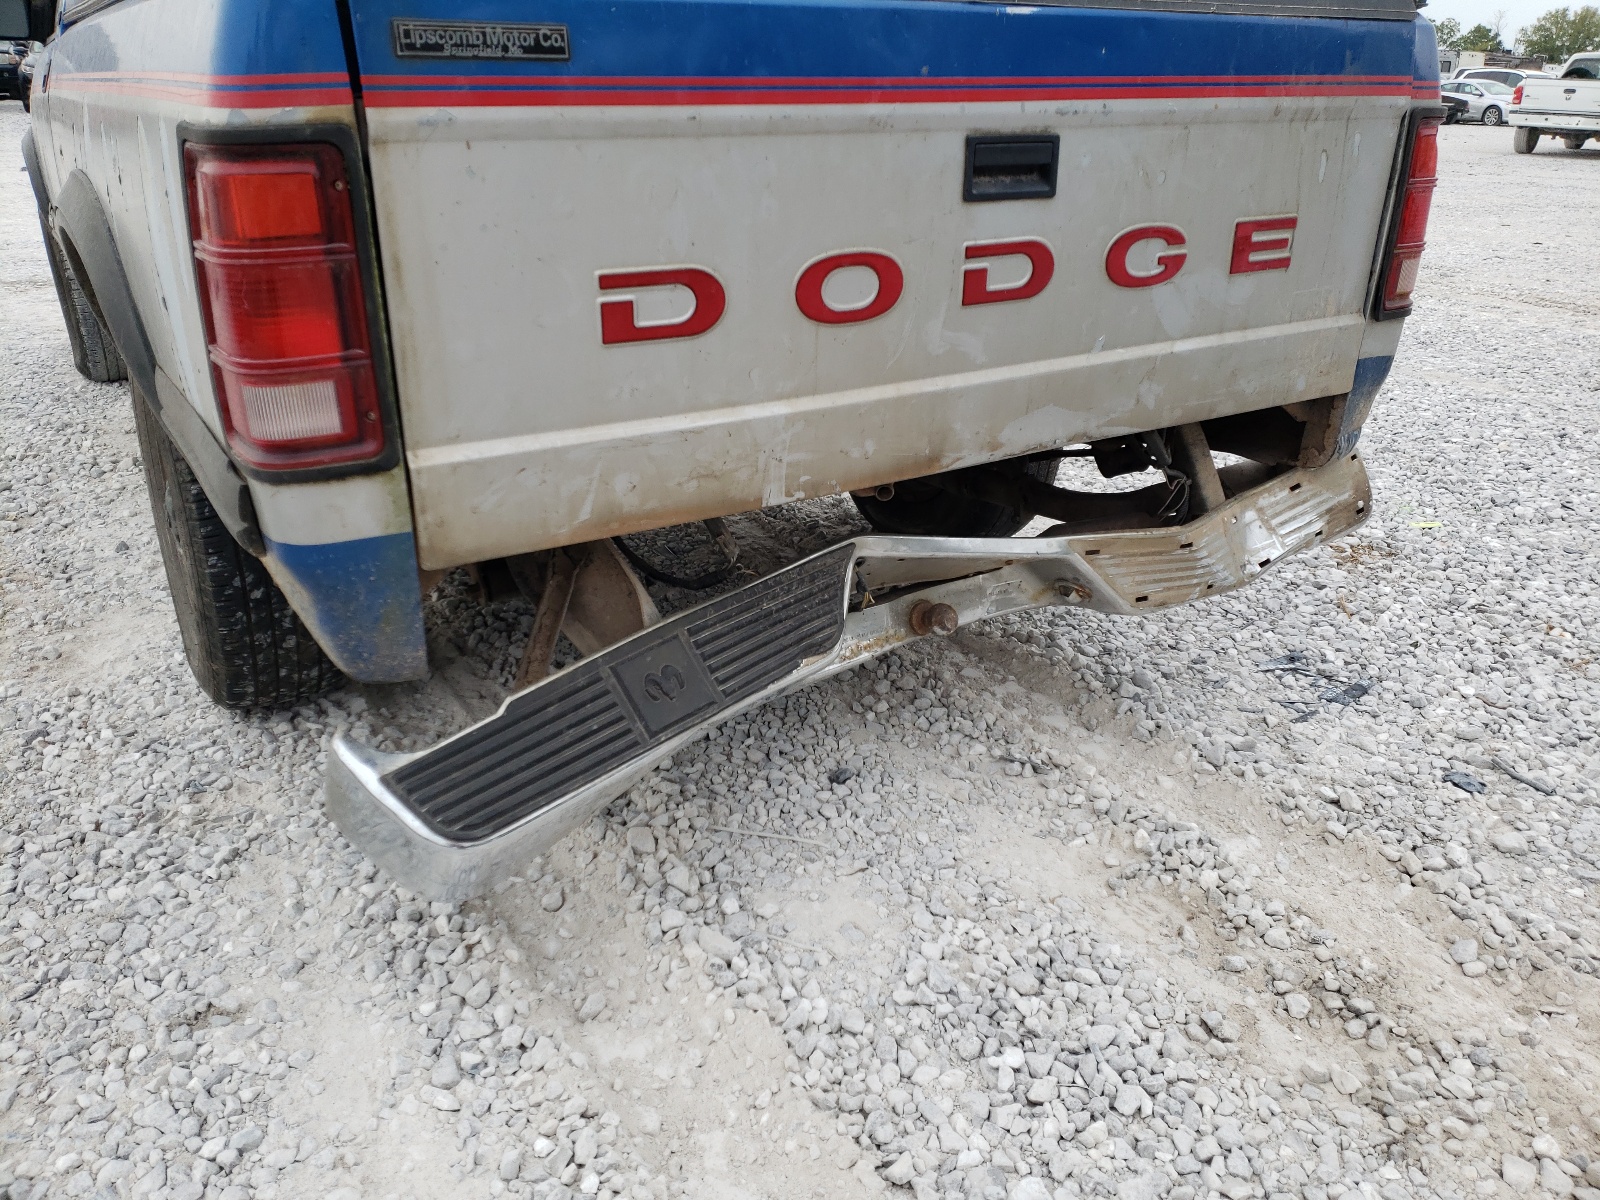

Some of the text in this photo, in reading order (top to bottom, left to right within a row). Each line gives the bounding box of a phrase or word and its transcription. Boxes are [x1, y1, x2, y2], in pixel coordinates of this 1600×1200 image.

[400, 25, 565, 47] Lipscomb Motor Co.
[595, 213, 1298, 346] DODGE
